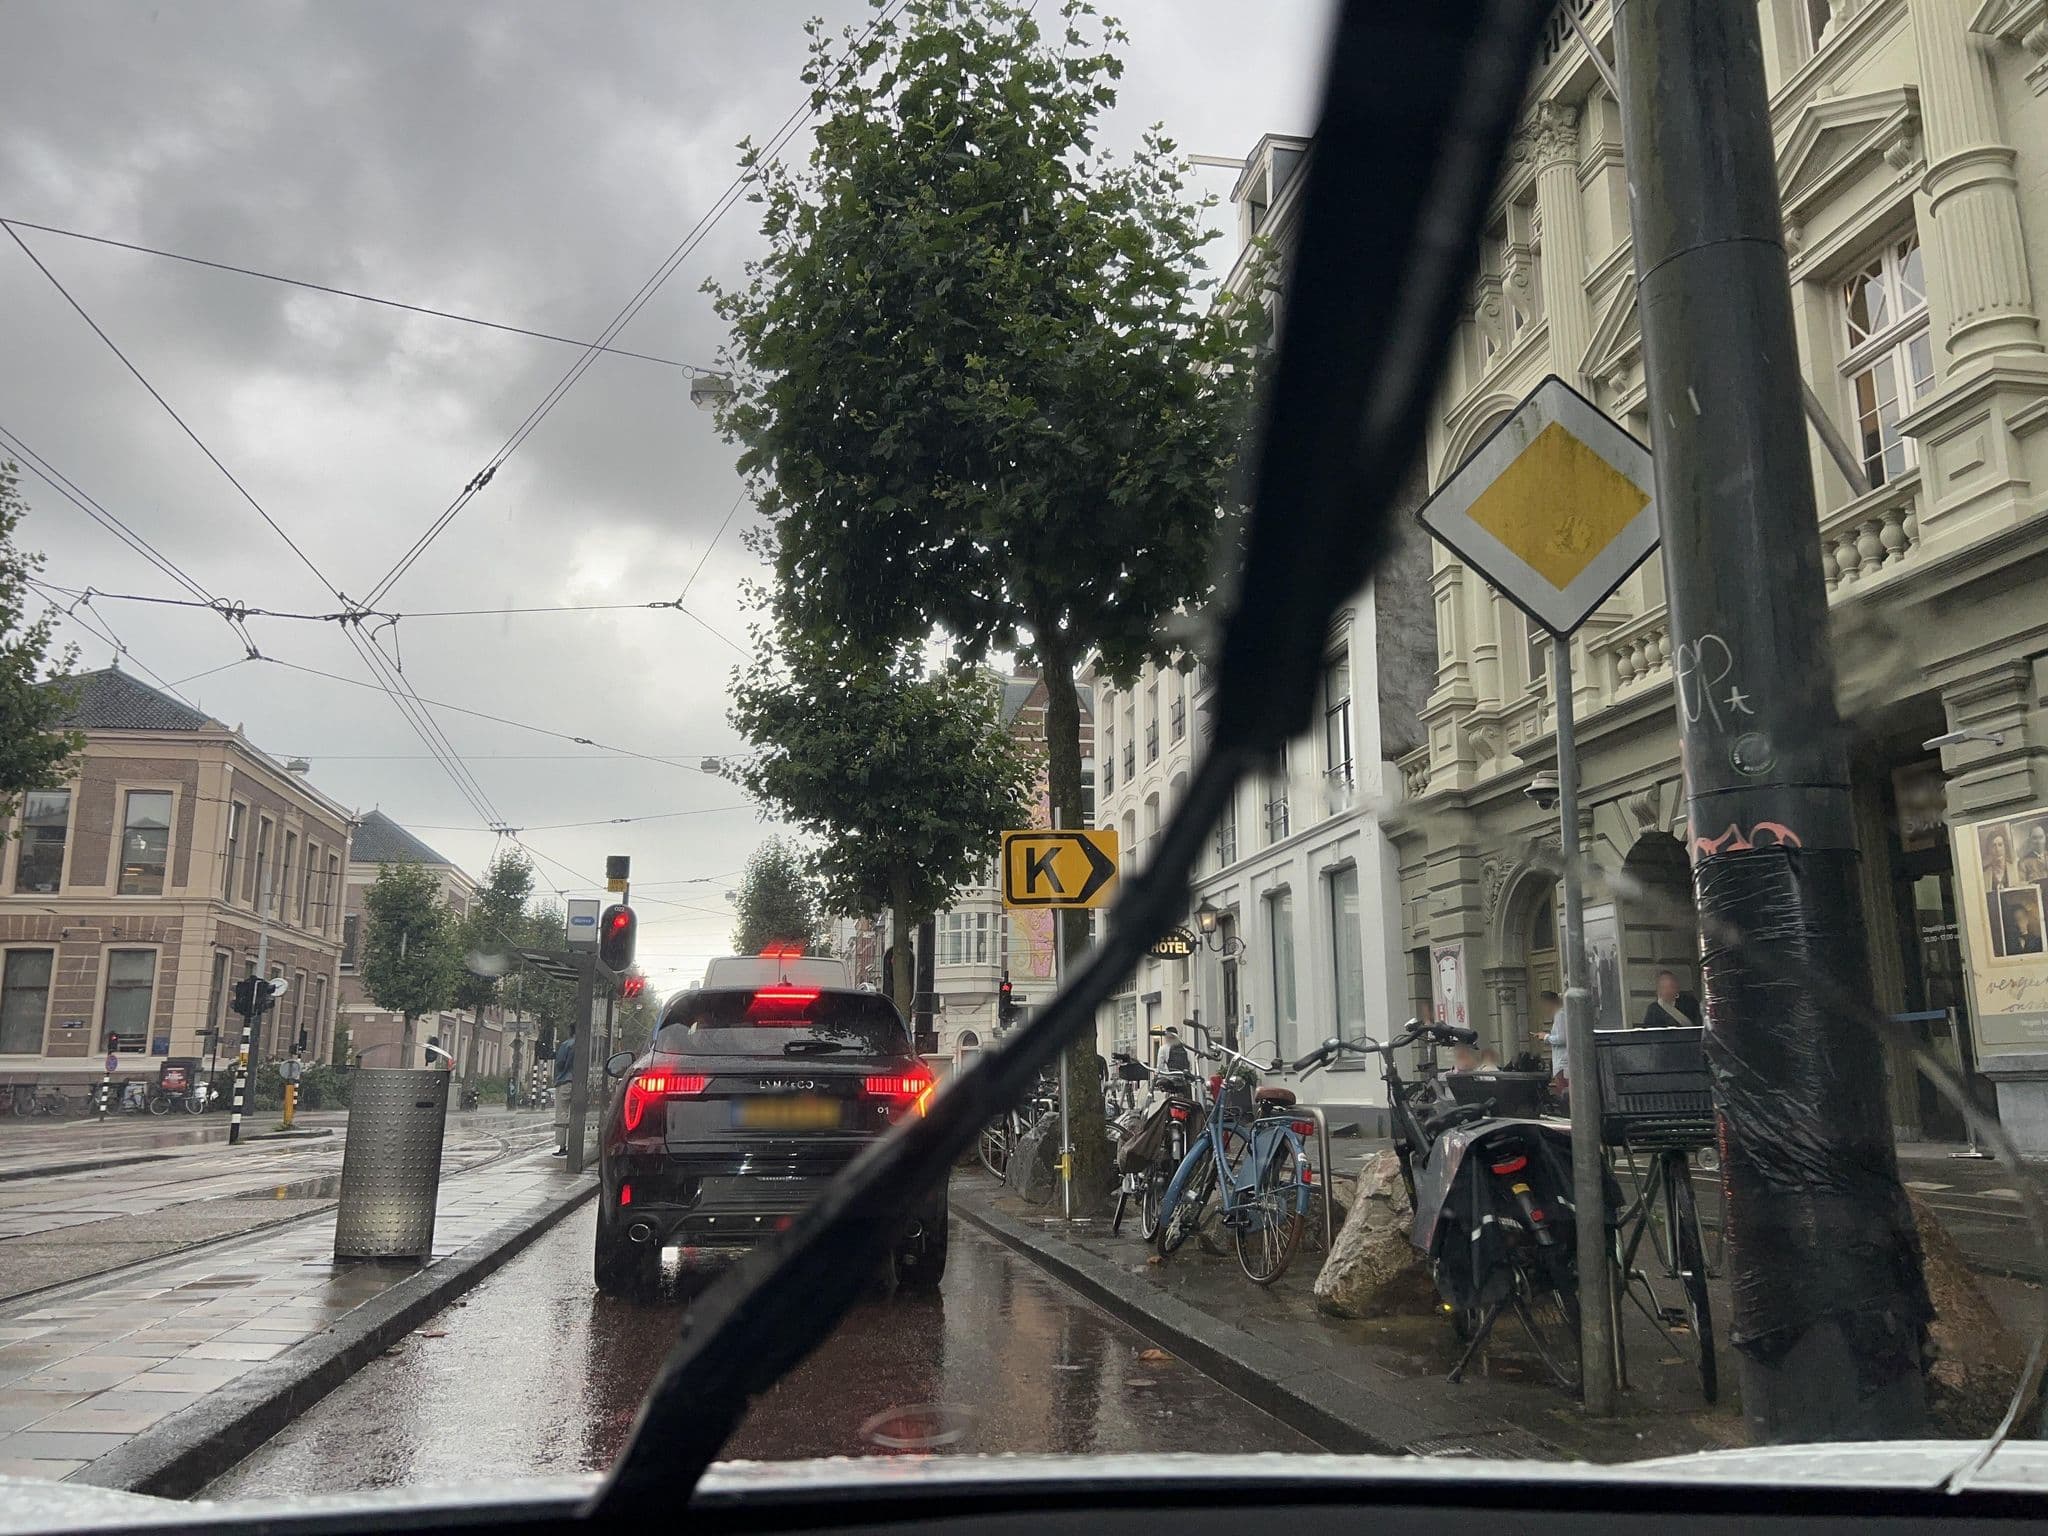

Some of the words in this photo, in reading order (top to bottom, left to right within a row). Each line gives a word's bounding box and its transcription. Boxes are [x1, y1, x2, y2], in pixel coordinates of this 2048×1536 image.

[1025, 846, 1065, 894] K
[1151, 941, 1190, 954] HOTEL
[877, 1106, 889, 1115] 01
